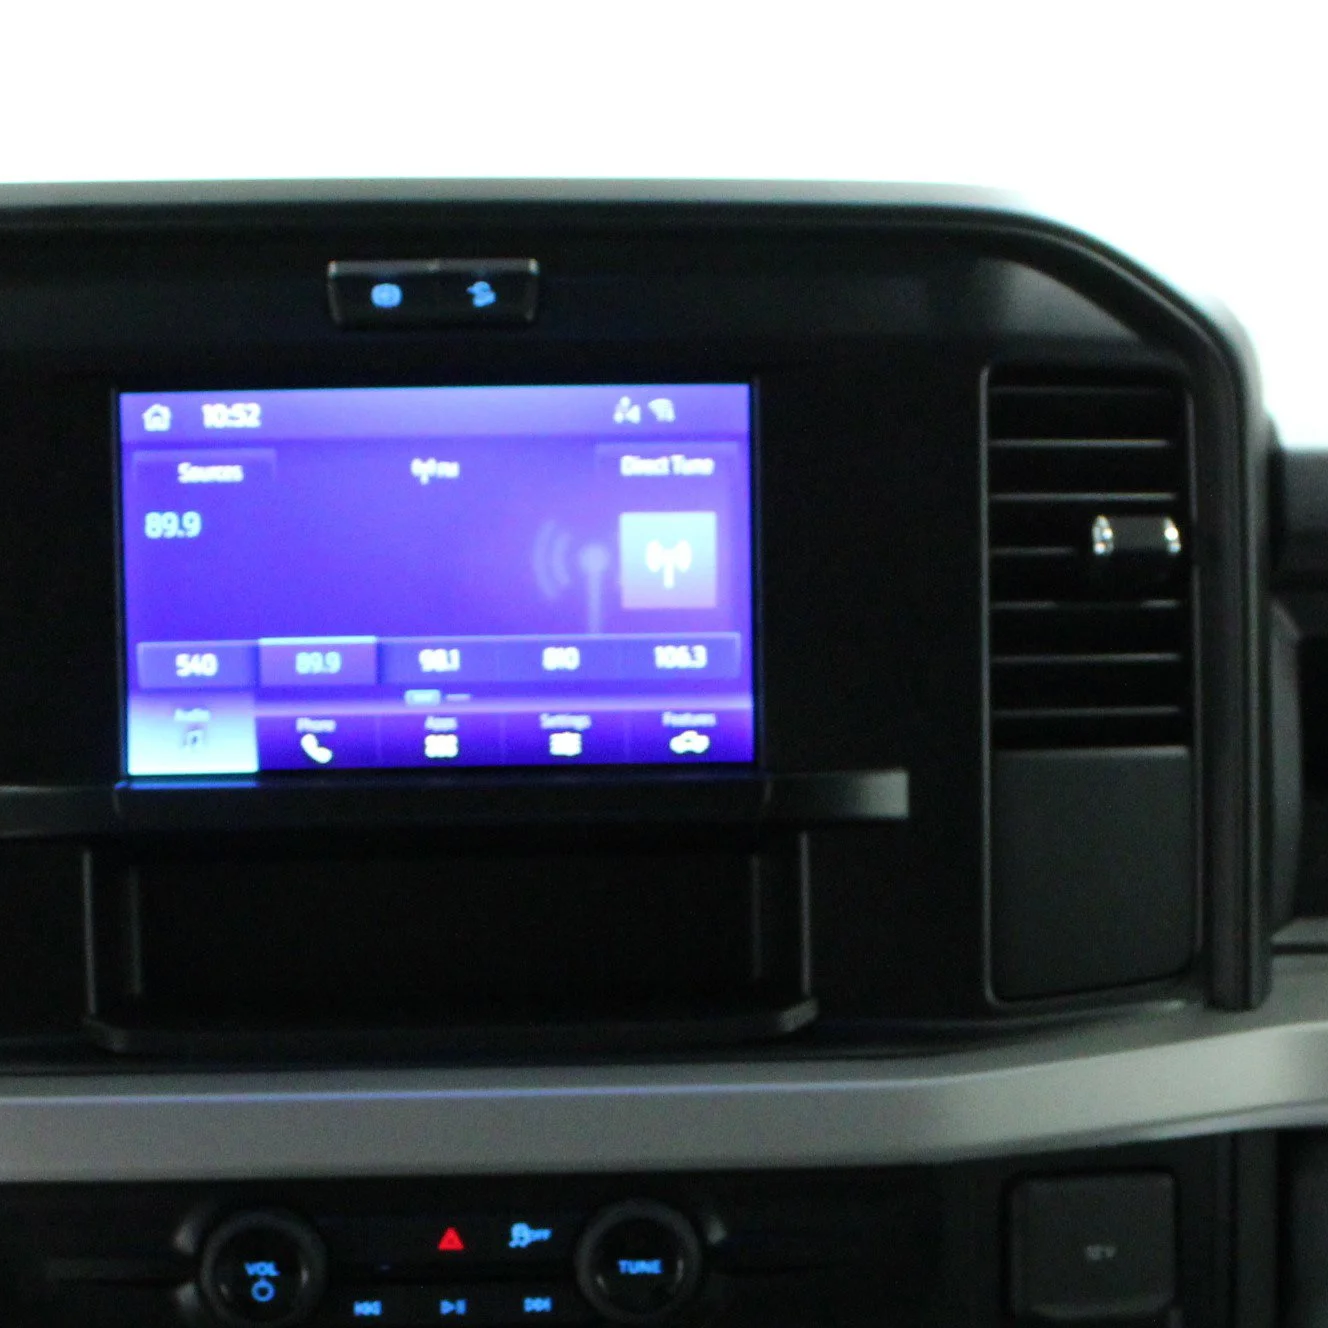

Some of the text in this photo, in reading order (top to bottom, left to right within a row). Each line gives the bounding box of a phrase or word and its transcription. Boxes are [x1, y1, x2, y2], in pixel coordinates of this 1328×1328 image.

[202, 403, 261, 428] 10:52
[144, 511, 202, 538] 89.9
[175, 653, 218, 677] 540
[244, 1261, 281, 1277] VOL
[618, 1259, 662, 1275] TUNE
